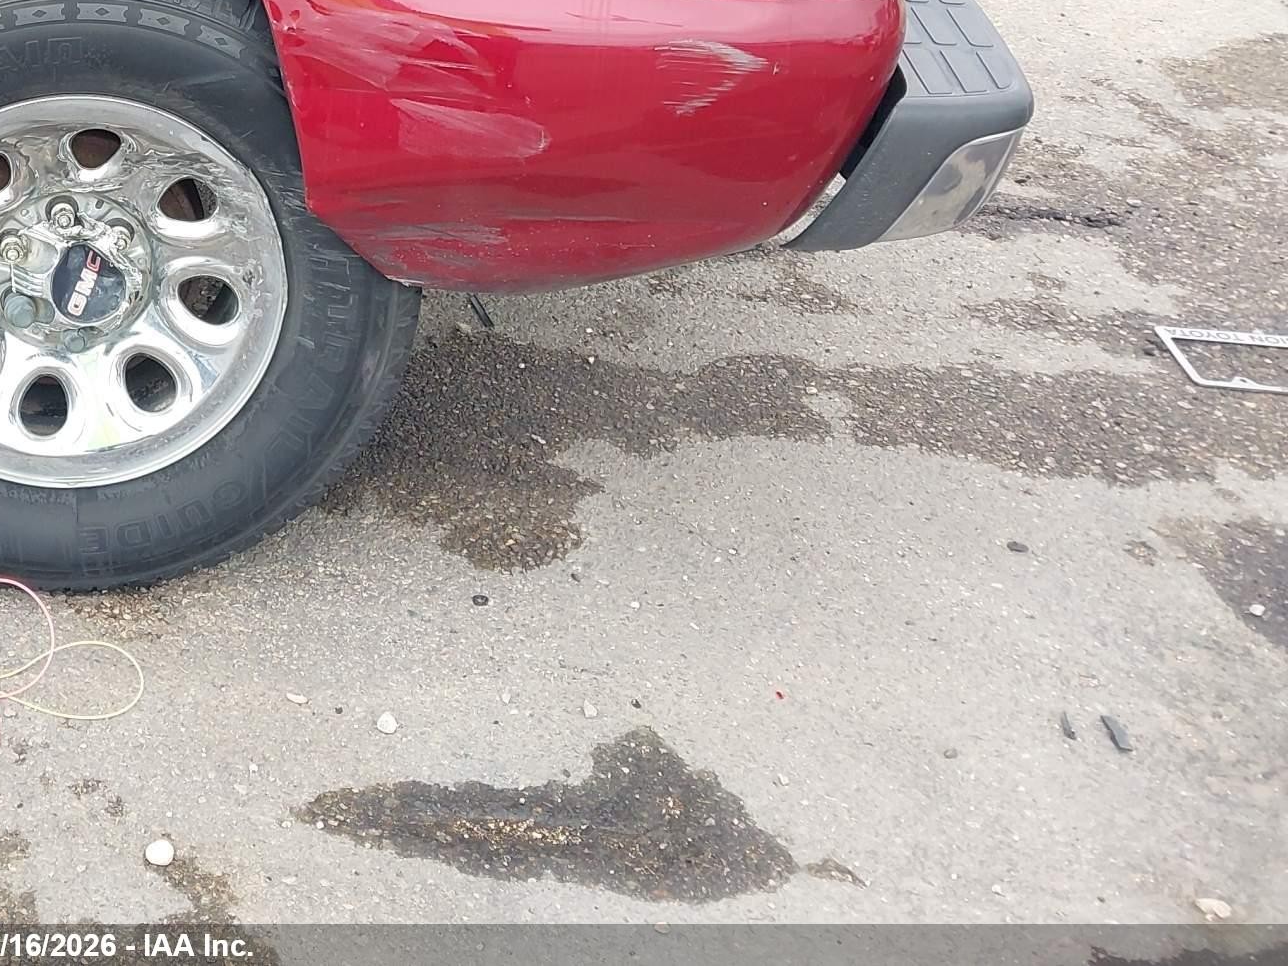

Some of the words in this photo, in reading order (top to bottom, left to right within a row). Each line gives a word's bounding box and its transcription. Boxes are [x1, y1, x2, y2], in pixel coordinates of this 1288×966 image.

[67, 250, 101, 316] GMC
[1164, 328, 1245, 342] TOYOTA
[78, 481, 244, 555] GUIDE
